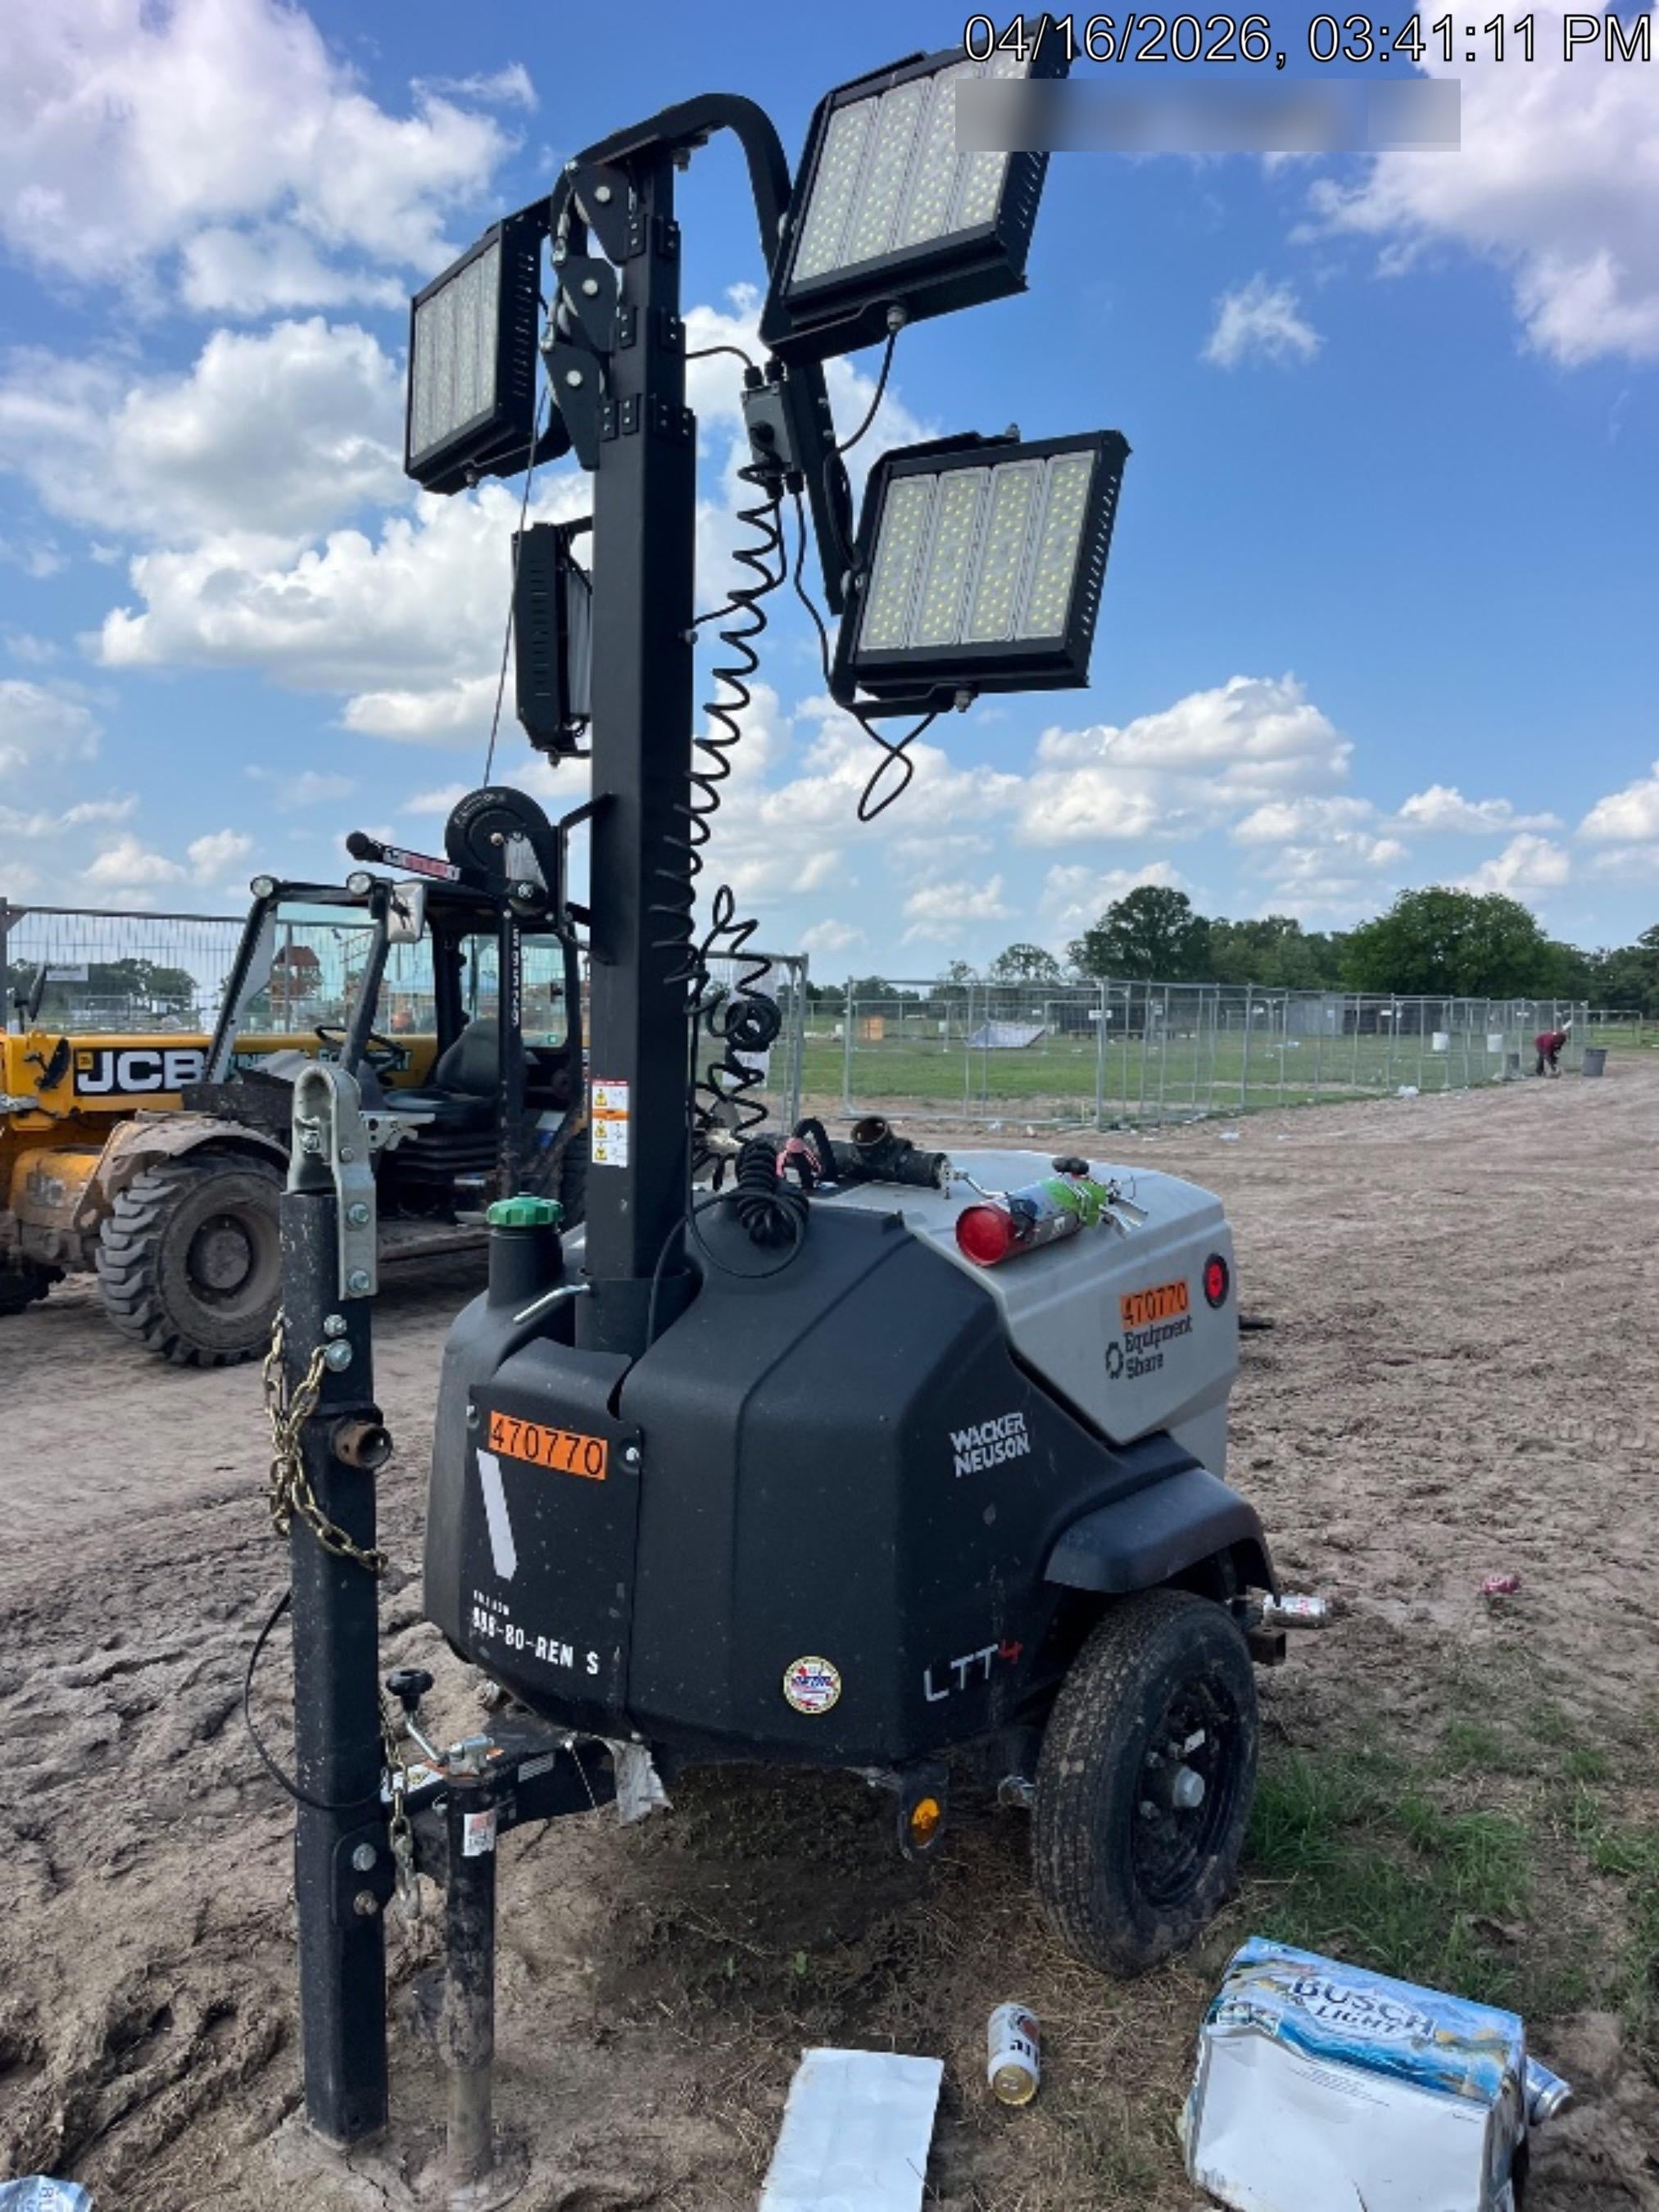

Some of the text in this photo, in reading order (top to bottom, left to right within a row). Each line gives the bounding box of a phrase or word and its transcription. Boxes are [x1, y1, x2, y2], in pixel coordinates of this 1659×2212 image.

[77, 1049, 204, 1093] JCB
[1124, 1314, 1193, 1355] Equipment
[491, 1417, 604, 1476] 470770
[949, 1412, 1026, 1453] WACKER
[953, 1432, 1031, 1478] NEUSON
[1293, 1976, 1435, 2037] BUSCH
[1314, 2005, 1398, 2033] LIGHT
